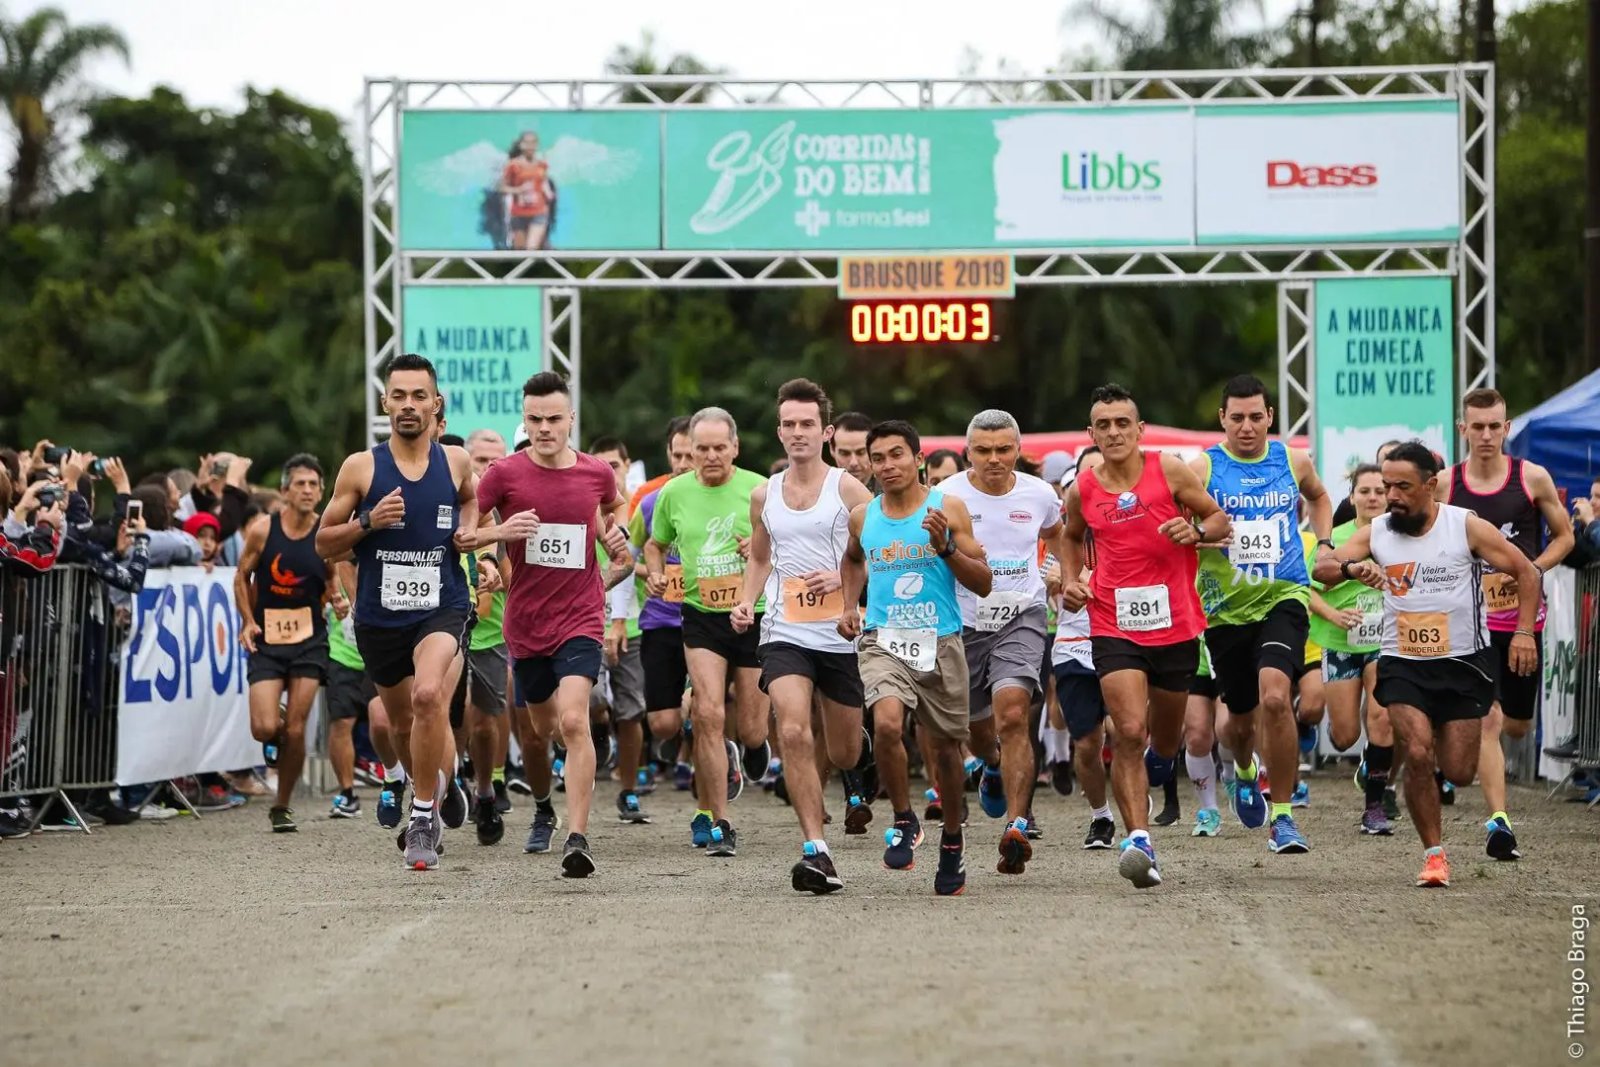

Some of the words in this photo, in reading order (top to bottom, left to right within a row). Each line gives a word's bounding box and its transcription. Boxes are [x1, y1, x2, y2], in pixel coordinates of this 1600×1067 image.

[795, 133, 916, 162] CORRIDAS
[795, 165, 836, 196] DO
[842, 163, 916, 196] BEM
[1062, 153, 1162, 191] Libbs
[1267, 161, 1378, 188] Dass
[849, 261, 945, 291] BRUSQUE
[955, 259, 1005, 288] 2019
[851, 303, 990, 342] 00:00:03
[1328, 308, 1339, 333] A
[417, 327, 427, 351] A
[1336, 371, 1376, 396] COM
[540, 538, 571, 554] 651
[1240, 534, 1272, 549] 943
[1238, 551, 1271, 561] MARCOS
[1421, 566, 1447, 575] Vieira
[396, 581, 431, 597] 939
[710, 587, 737, 602] 077
[1487, 586, 1514, 600] 14
[389, 598, 431, 608] MARCELO
[796, 592, 825, 607] 197
[990, 605, 1020, 620] 724
[1130, 600, 1159, 617] 891
[276, 620, 299, 633] 141
[1118, 616, 1169, 628] ALESSANDRO
[1359, 624, 1384, 638] 656
[1408, 628, 1441, 644] 063
[1402, 644, 1445, 654] VANDERLEI
